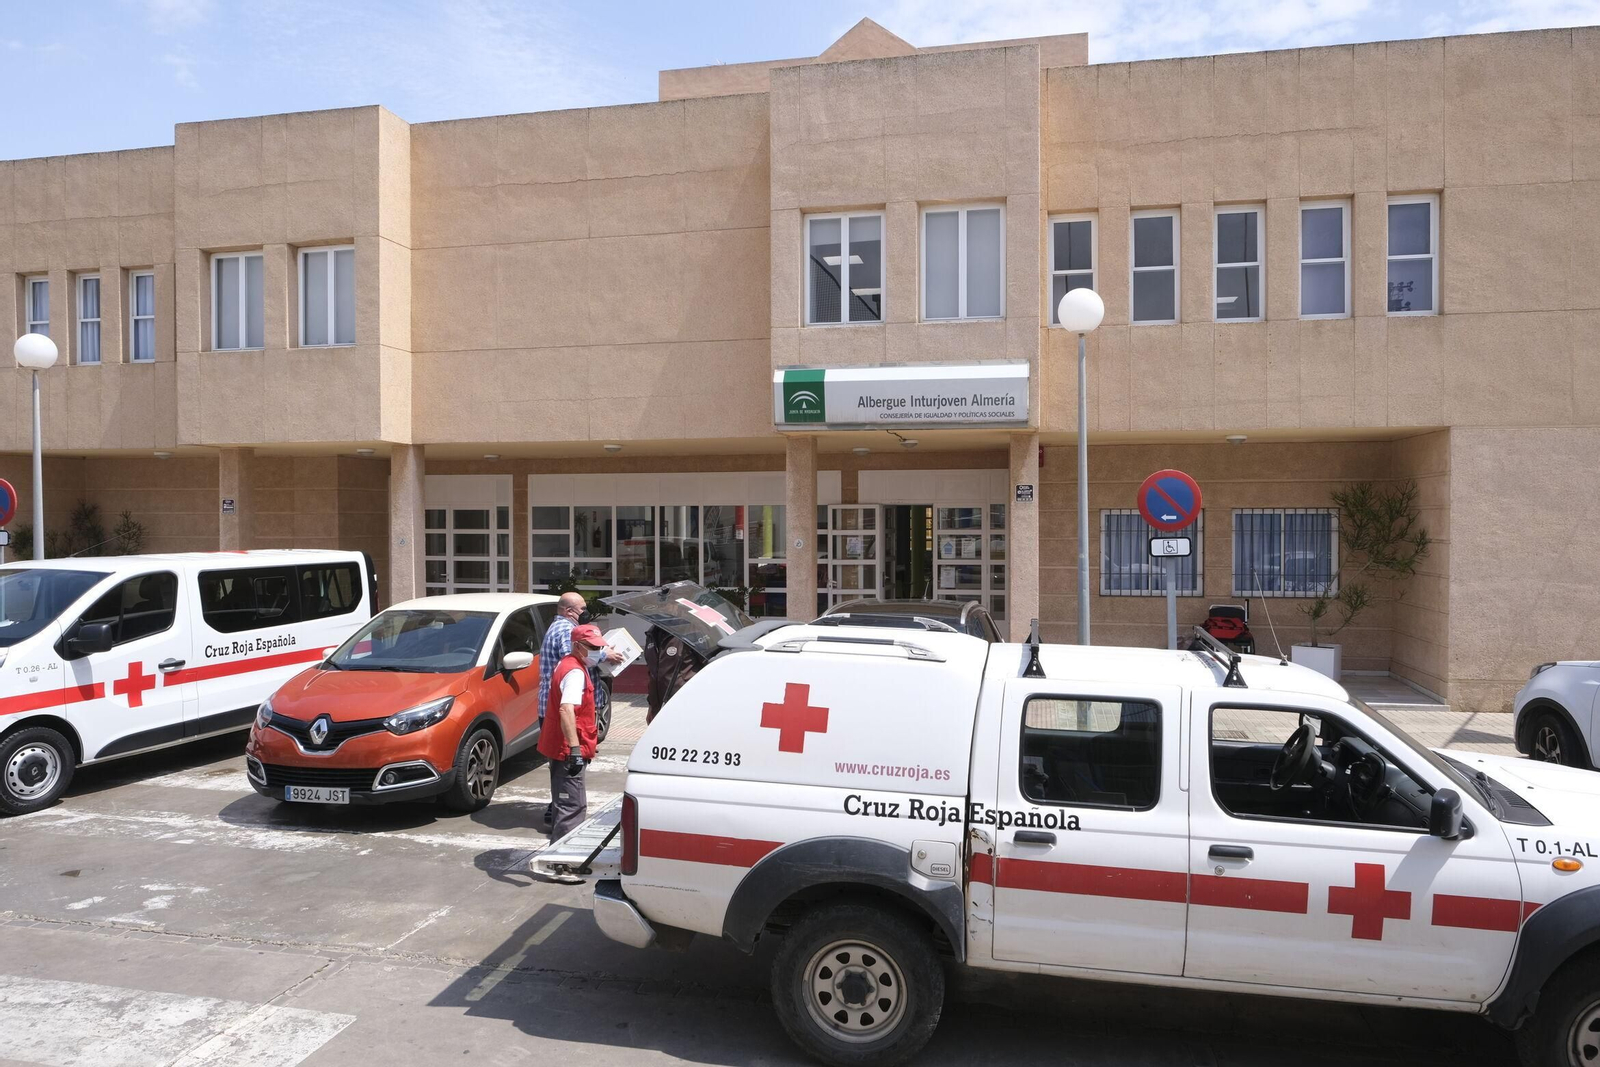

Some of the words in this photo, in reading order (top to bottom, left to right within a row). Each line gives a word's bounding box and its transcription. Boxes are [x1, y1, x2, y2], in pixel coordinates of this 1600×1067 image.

[857, 395, 906, 411] Albergue
[910, 394, 967, 410] Inturjoven
[971, 392, 1015, 406] Almería
[204, 644, 230, 658] Cruz
[231, 640, 254, 656] Roja
[256, 633, 296, 652] Española
[47, 662, 58, 671] AL
[652, 746, 677, 761] 902
[681, 748, 698, 762] 22
[702, 750, 720, 765] 23
[724, 752, 741, 766] 93
[834, 762, 951, 782] www.cruzroja.es
[292, 787, 321, 801] 9924
[325, 789, 347, 802] JST
[843, 794, 900, 819] Cruz
[908, 798, 962, 827] Roja
[969, 802, 1082, 831] Española
[1516, 837, 1529, 853] T
[1535, 839, 1599, 858] 0.1-AL
[932, 865, 949, 873] DIESEL
